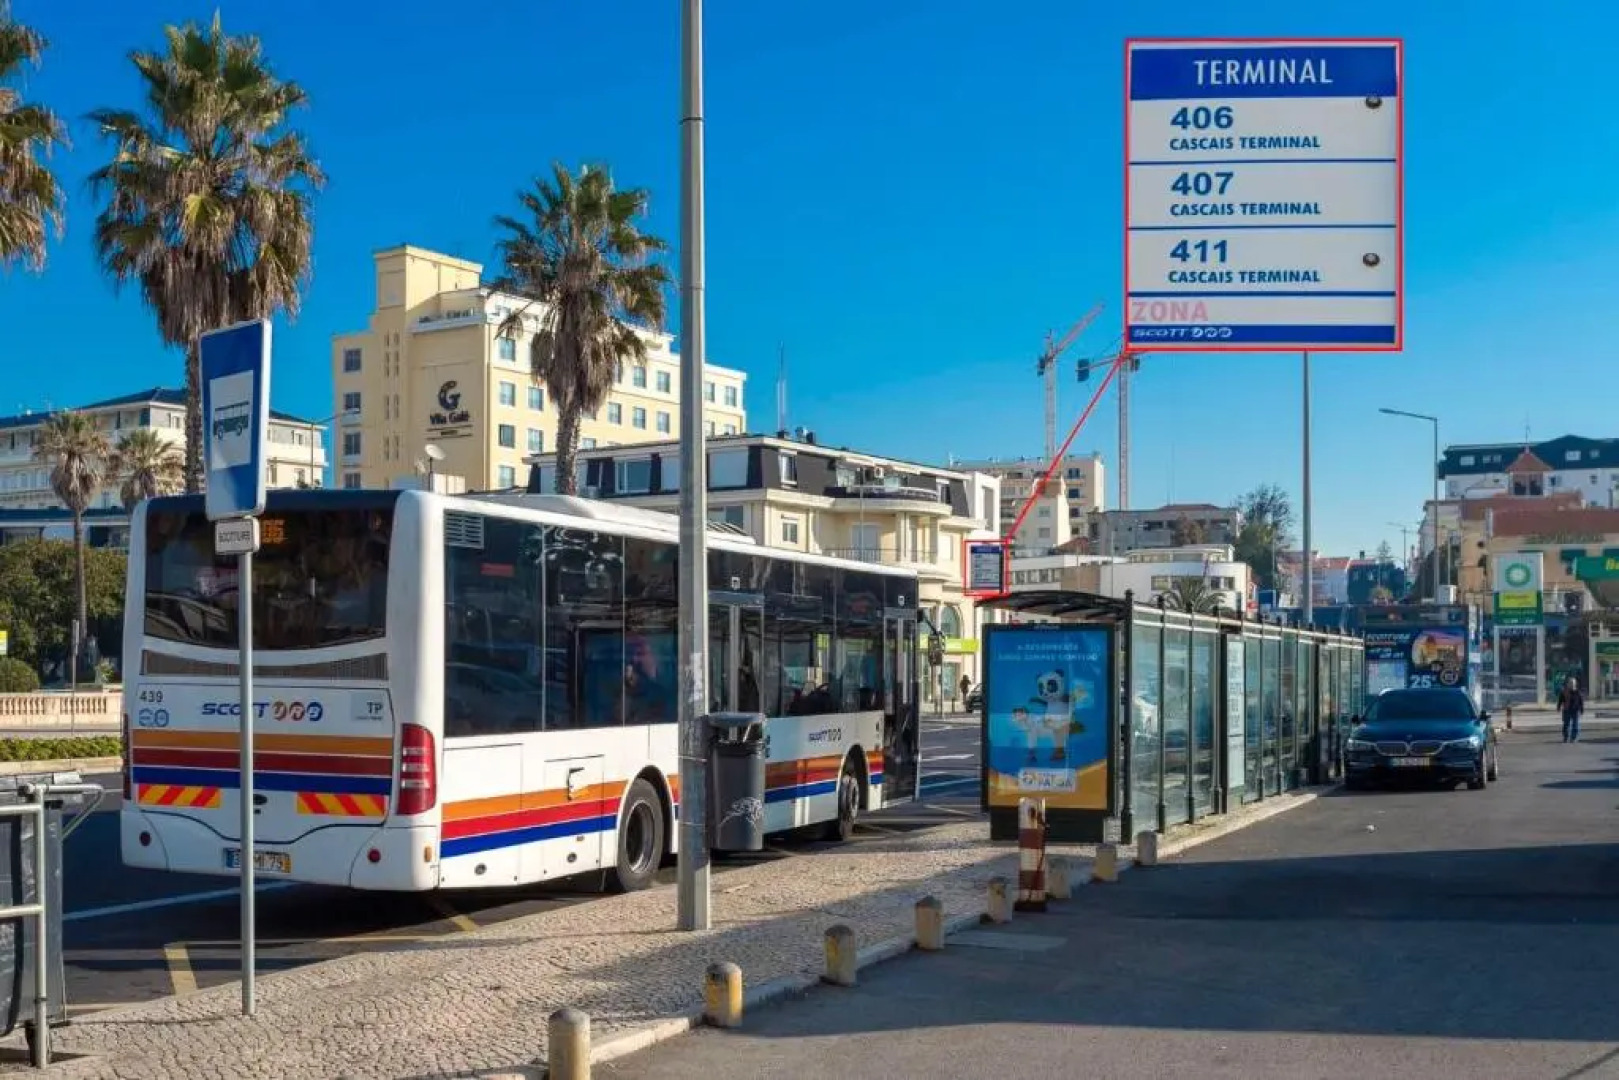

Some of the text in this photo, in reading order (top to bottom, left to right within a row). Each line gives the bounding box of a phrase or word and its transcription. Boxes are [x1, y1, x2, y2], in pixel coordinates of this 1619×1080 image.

[1194, 59, 1334, 85] TERMINAL
[1169, 106, 1234, 129] 406
[1169, 136, 1321, 151] CASCAIS TERMINAL
[1170, 172, 1234, 196] 407
[1169, 202, 1322, 216] CASCAIS TERMINAL
[1169, 239, 1228, 263] 411
[1168, 270, 1322, 284] CASCAIS TERMINAL
[1132, 301, 1208, 322] ZONA
[139, 690, 164, 703] 439
